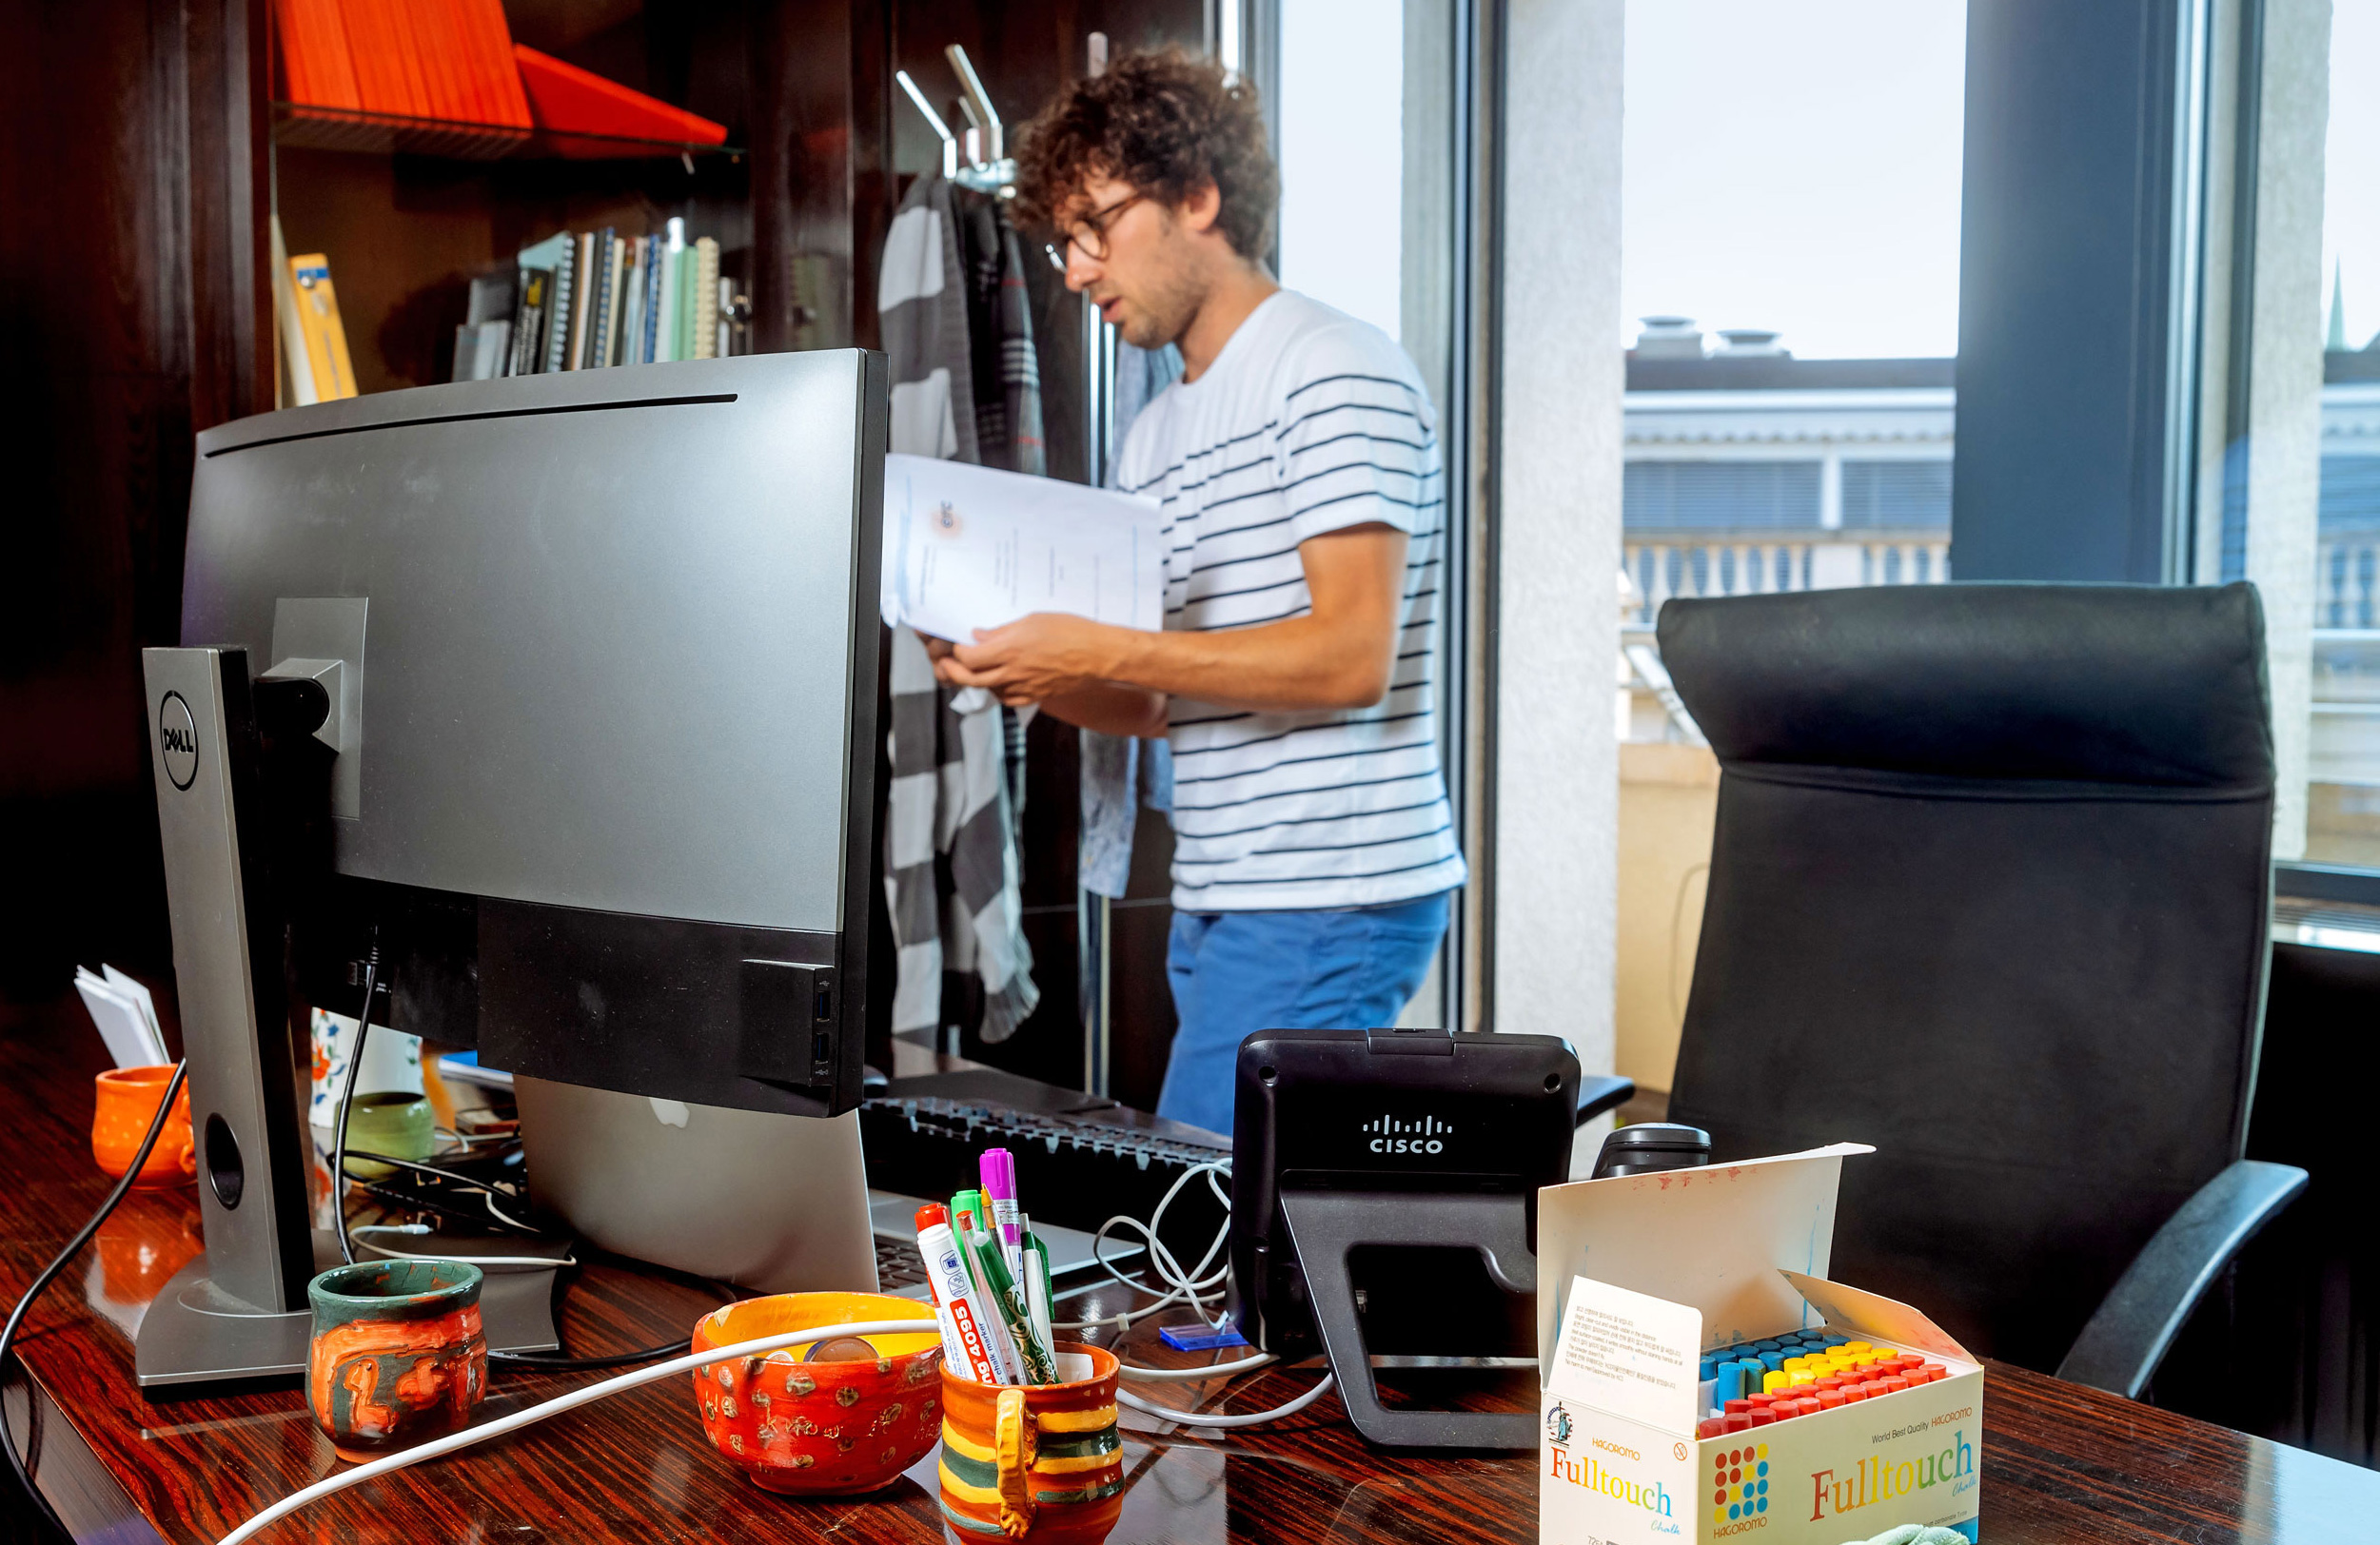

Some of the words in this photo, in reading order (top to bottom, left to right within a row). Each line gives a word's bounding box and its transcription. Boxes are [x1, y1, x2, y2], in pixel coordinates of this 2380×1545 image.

[163, 728, 194, 753] DELL
[1369, 1139, 1443, 1154] CISCO
[954, 1305, 981, 1357] 4095
[978, 1322, 993, 1351] marker
[990, 1353, 1002, 1376] chalk
[1871, 1429, 1891, 1444] World
[1892, 1427, 1906, 1438] Best
[1907, 1421, 1929, 1435] Quality
[1931, 1406, 1973, 1428] HAGOROMO
[1592, 1437, 1641, 1461] HAGOROMO
[1550, 1446, 1673, 1518] Fulltouch
[1809, 1429, 1974, 1523] Fulltouch
[1650, 1519, 1681, 1535] Chalk
[1713, 1516, 1767, 1539] HAGOROMO
